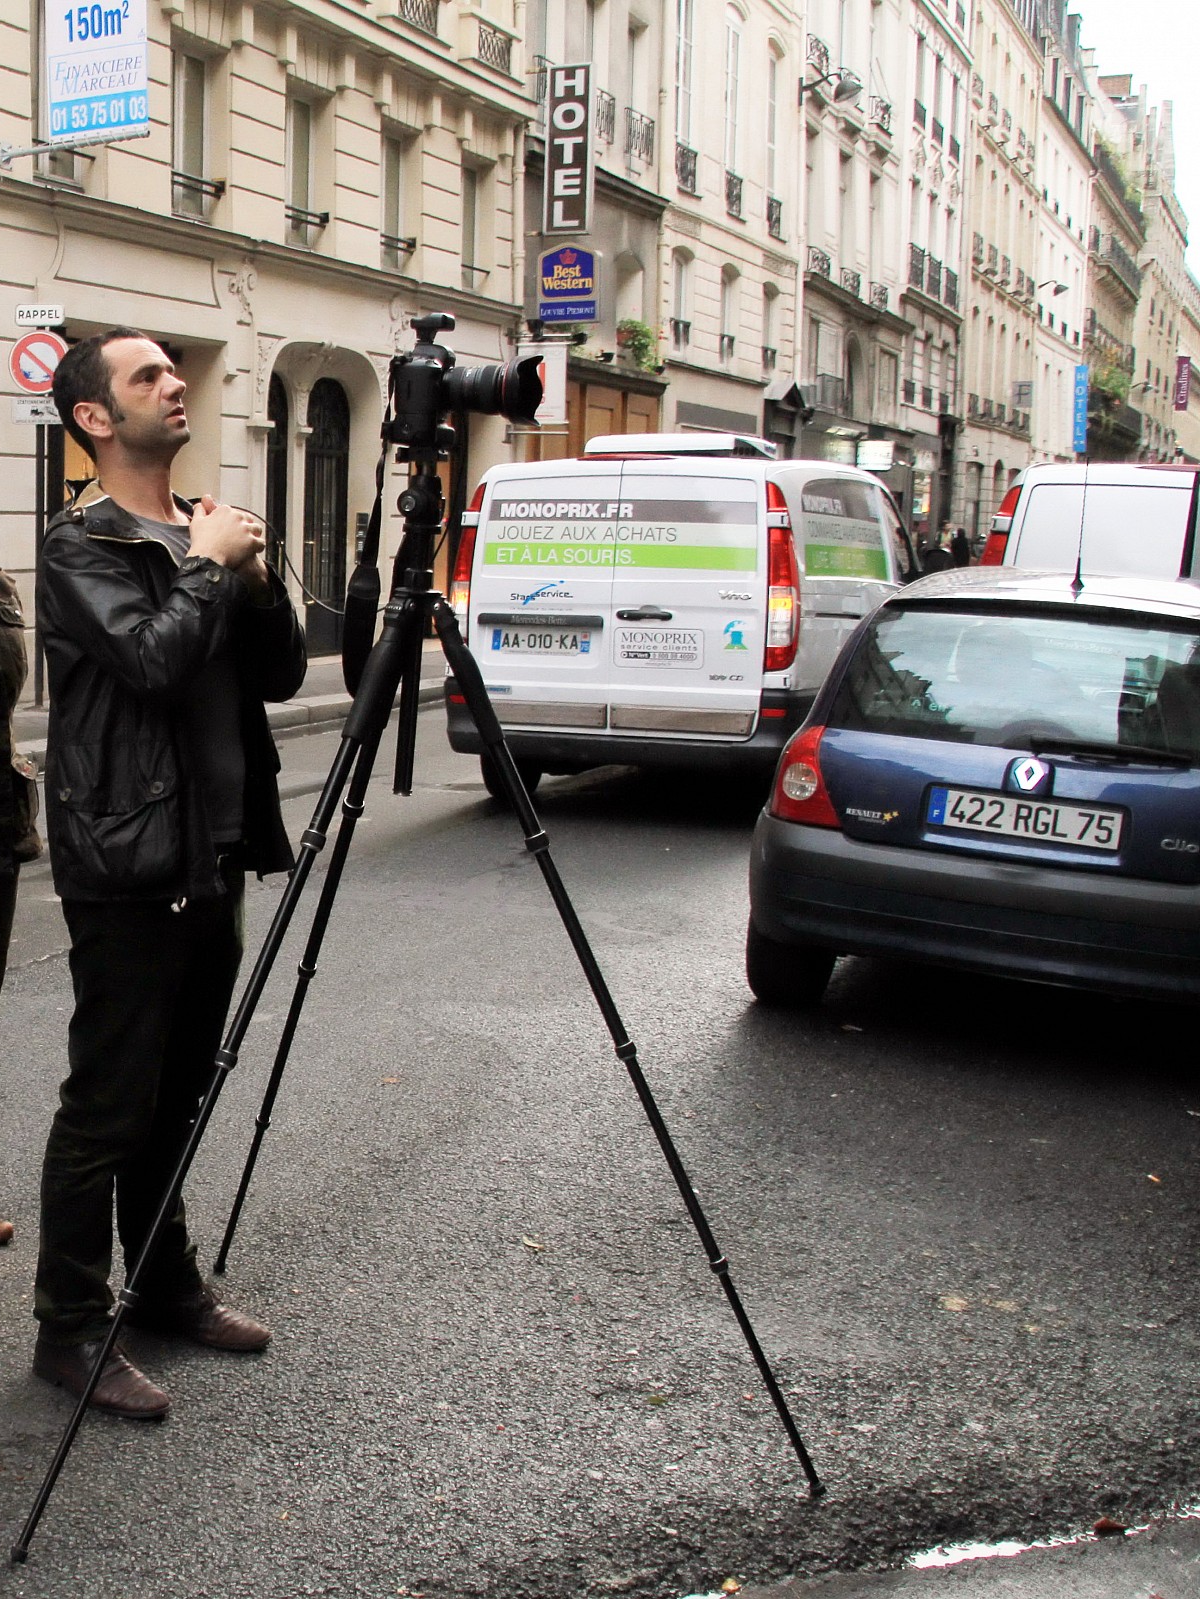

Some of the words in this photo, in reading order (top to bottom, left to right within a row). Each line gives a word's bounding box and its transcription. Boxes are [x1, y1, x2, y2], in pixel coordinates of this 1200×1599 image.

[55, 56, 142, 81] FINANCIERE
[61, 71, 138, 96] MARCEAU
[52, 107, 67, 131] 01
[72, 104, 87, 128] 53
[90, 101, 107, 125] 75
[110, 98, 124, 122] 01
[129, 96, 146, 120] 03
[553, 68, 586, 228] HOTEL
[553, 264, 582, 279] Best
[542, 277, 593, 290] Western
[19, 310, 60, 319] RAPPEL
[1178, 363, 1189, 404] Citadines
[1074, 373, 1085, 437] HOTEL
[500, 502, 633, 518] MONOPRIX.FR
[497, 525, 554, 541] JOUEZ
[560, 526, 597, 541] AUX
[602, 526, 677, 543] ACHATS
[497, 548, 516, 563] ET
[520, 546, 532, 563] À
[537, 549, 559, 563] LA
[563, 550, 636, 565] SOURIS.
[501, 632, 579, 650] AA-010-KA
[621, 632, 697, 644] MONOPRIX
[933, 810, 940, 818] F
[950, 796, 1005, 829] 422
[1013, 804, 1068, 839] RGL
[1077, 812, 1115, 844] 75
[1160, 838, 1200, 853] Clio
